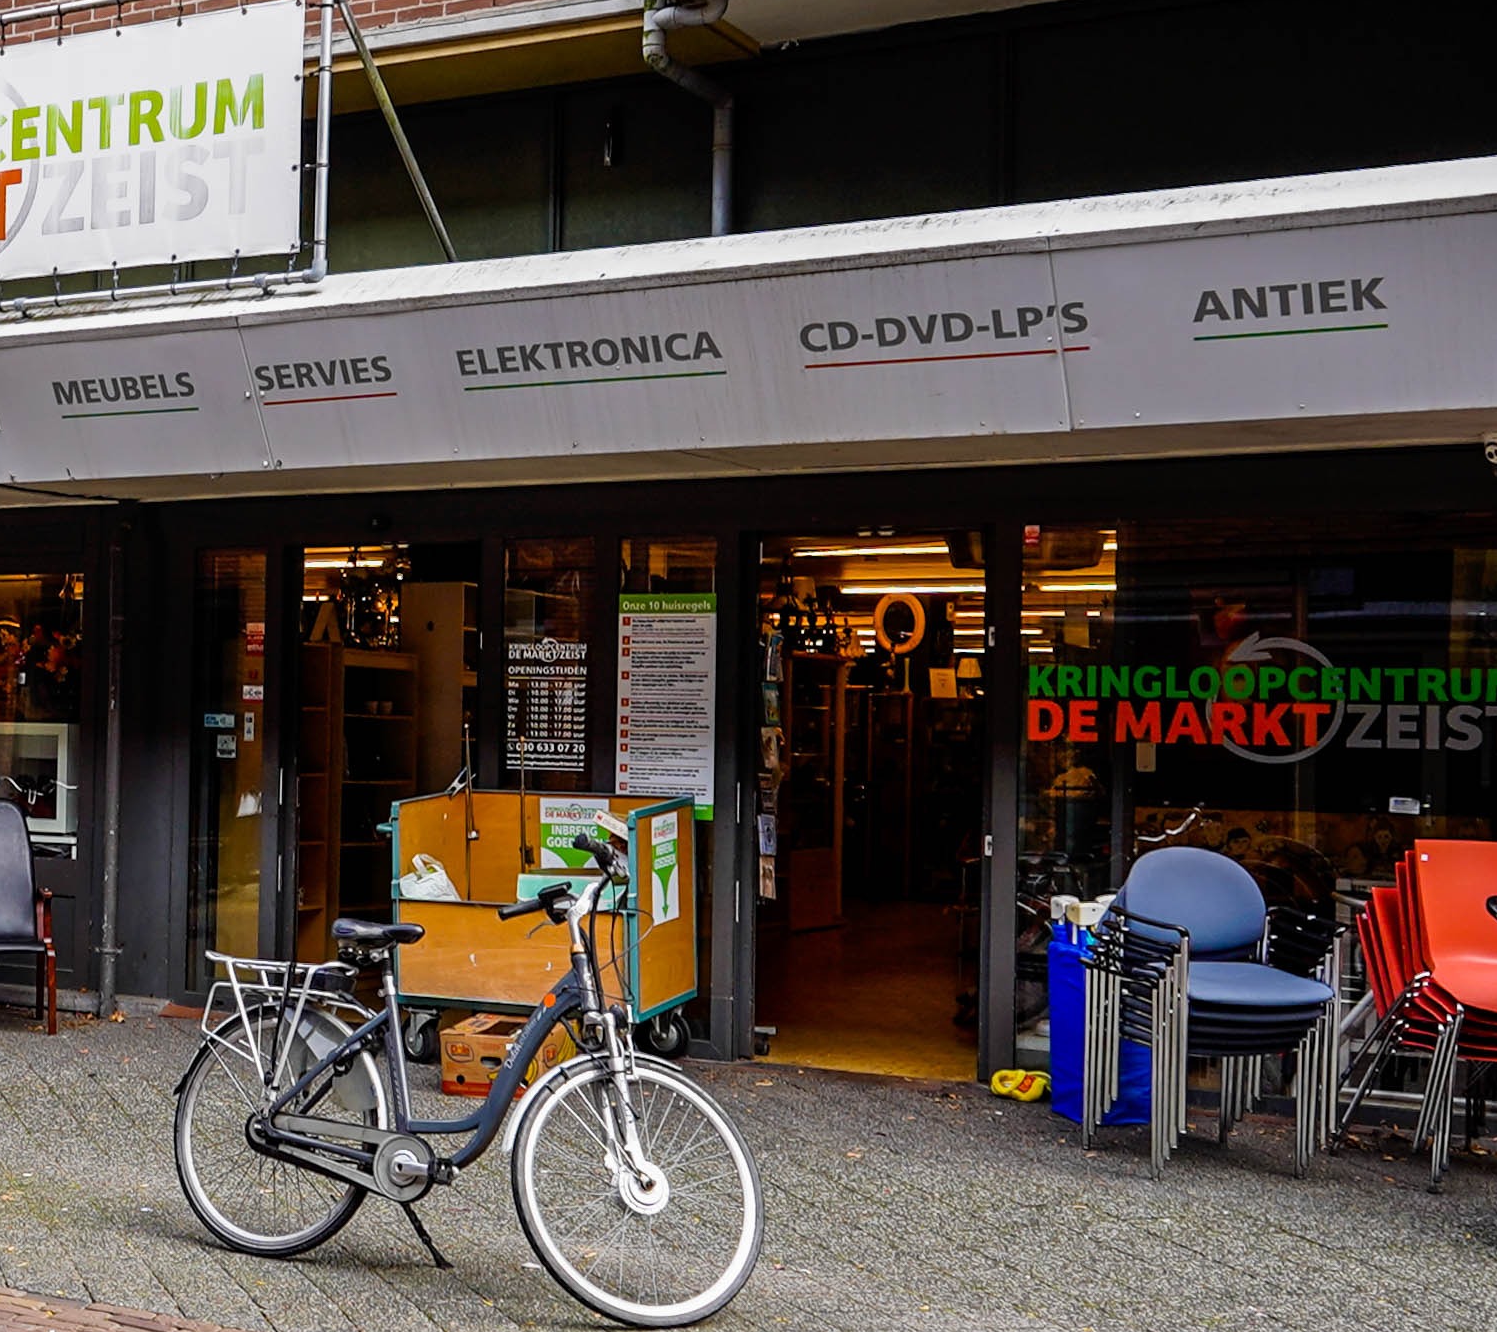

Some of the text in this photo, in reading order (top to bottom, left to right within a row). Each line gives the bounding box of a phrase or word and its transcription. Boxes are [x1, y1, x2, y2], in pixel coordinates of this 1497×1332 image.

[41, 136, 267, 236] ZEIST
[1192, 276, 1388, 325] ANTIEK
[798, 300, 1090, 355] CD-DVD-LP'S
[455, 329, 724, 378] ELEKTRONICA
[51, 371, 196, 406] MEUBELS
[254, 355, 393, 392] SERVIES
[622, 600, 712, 613] Onze 10 huisregels
[507, 665, 587, 676] OPENINGSTIJDEN
[508, 650, 587, 660] DE MARKT ZEIST
[1027, 700, 1099, 743] DE
[1115, 700, 1332, 748] MARKT
[536, 743, 555, 752] 633
[557, 744, 570, 753] 07
[572, 744, 586, 753] 20
[551, 825, 598, 837] INBRENG
